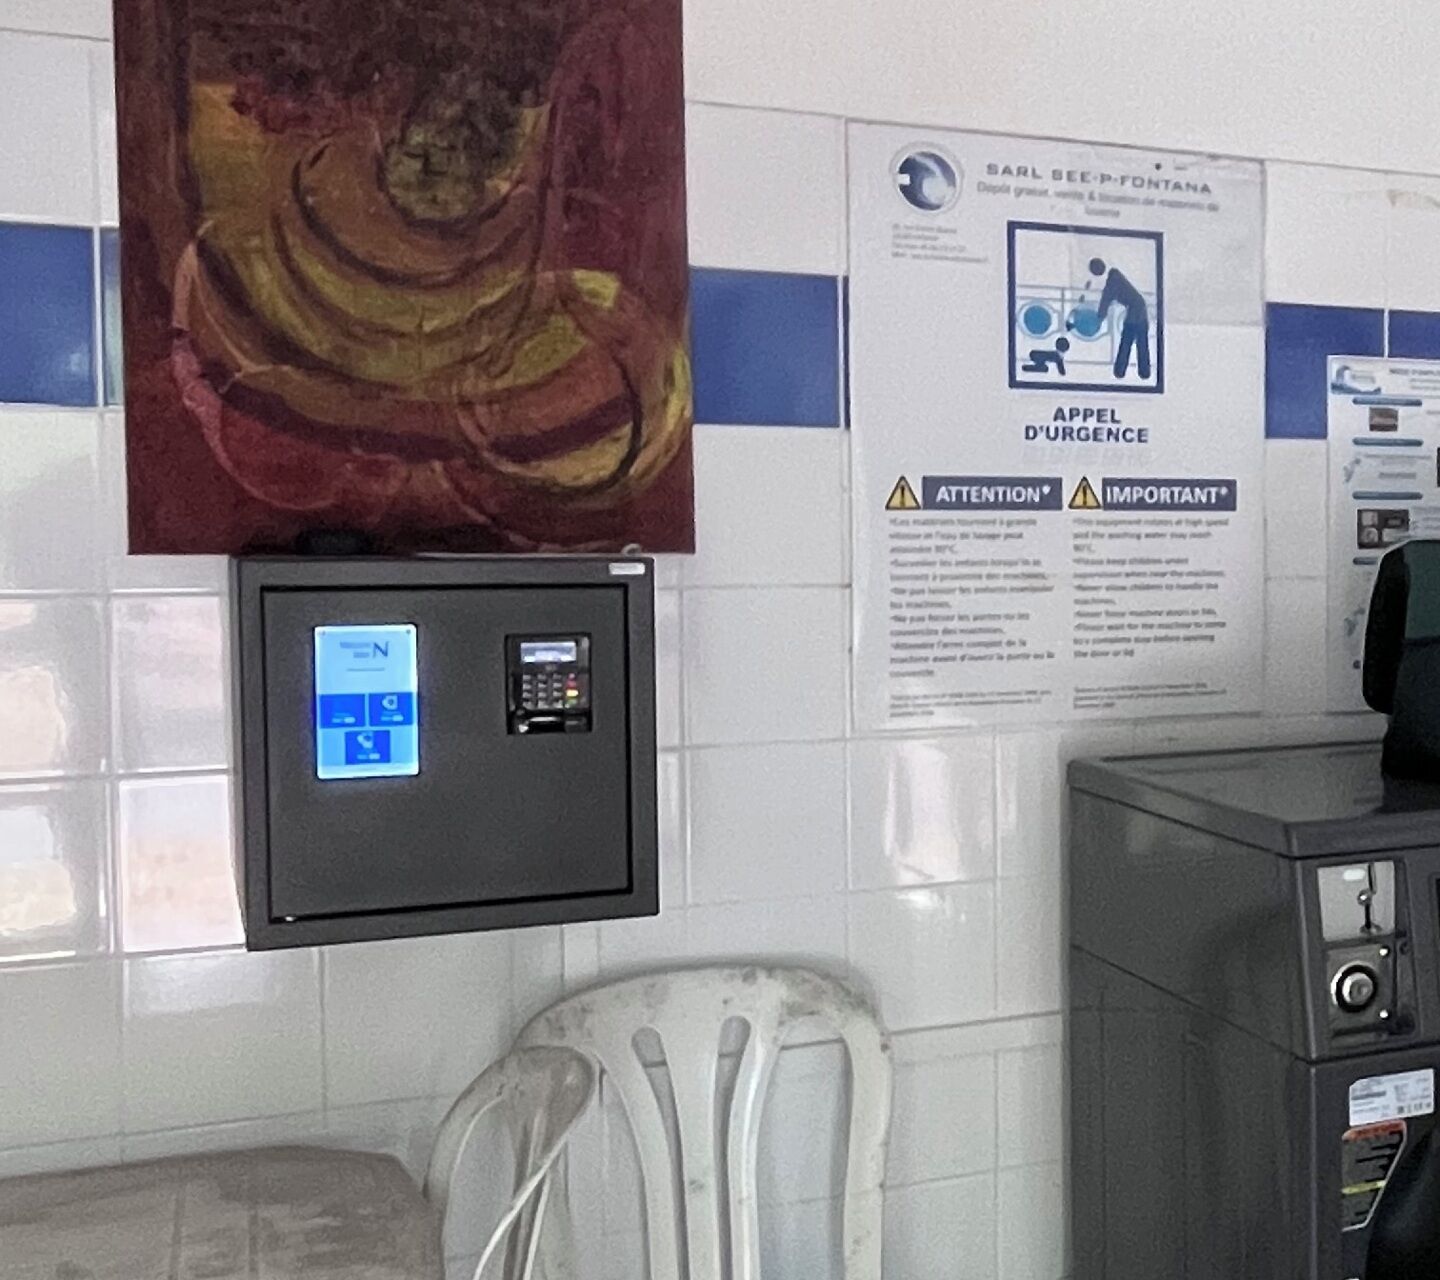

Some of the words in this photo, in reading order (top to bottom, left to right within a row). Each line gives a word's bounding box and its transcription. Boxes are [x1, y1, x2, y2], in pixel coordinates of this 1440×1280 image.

[985, 162, 1043, 180] SARL
[1052, 405, 1122, 425] APPEL
[1024, 424, 1149, 444] D'URGENCE
